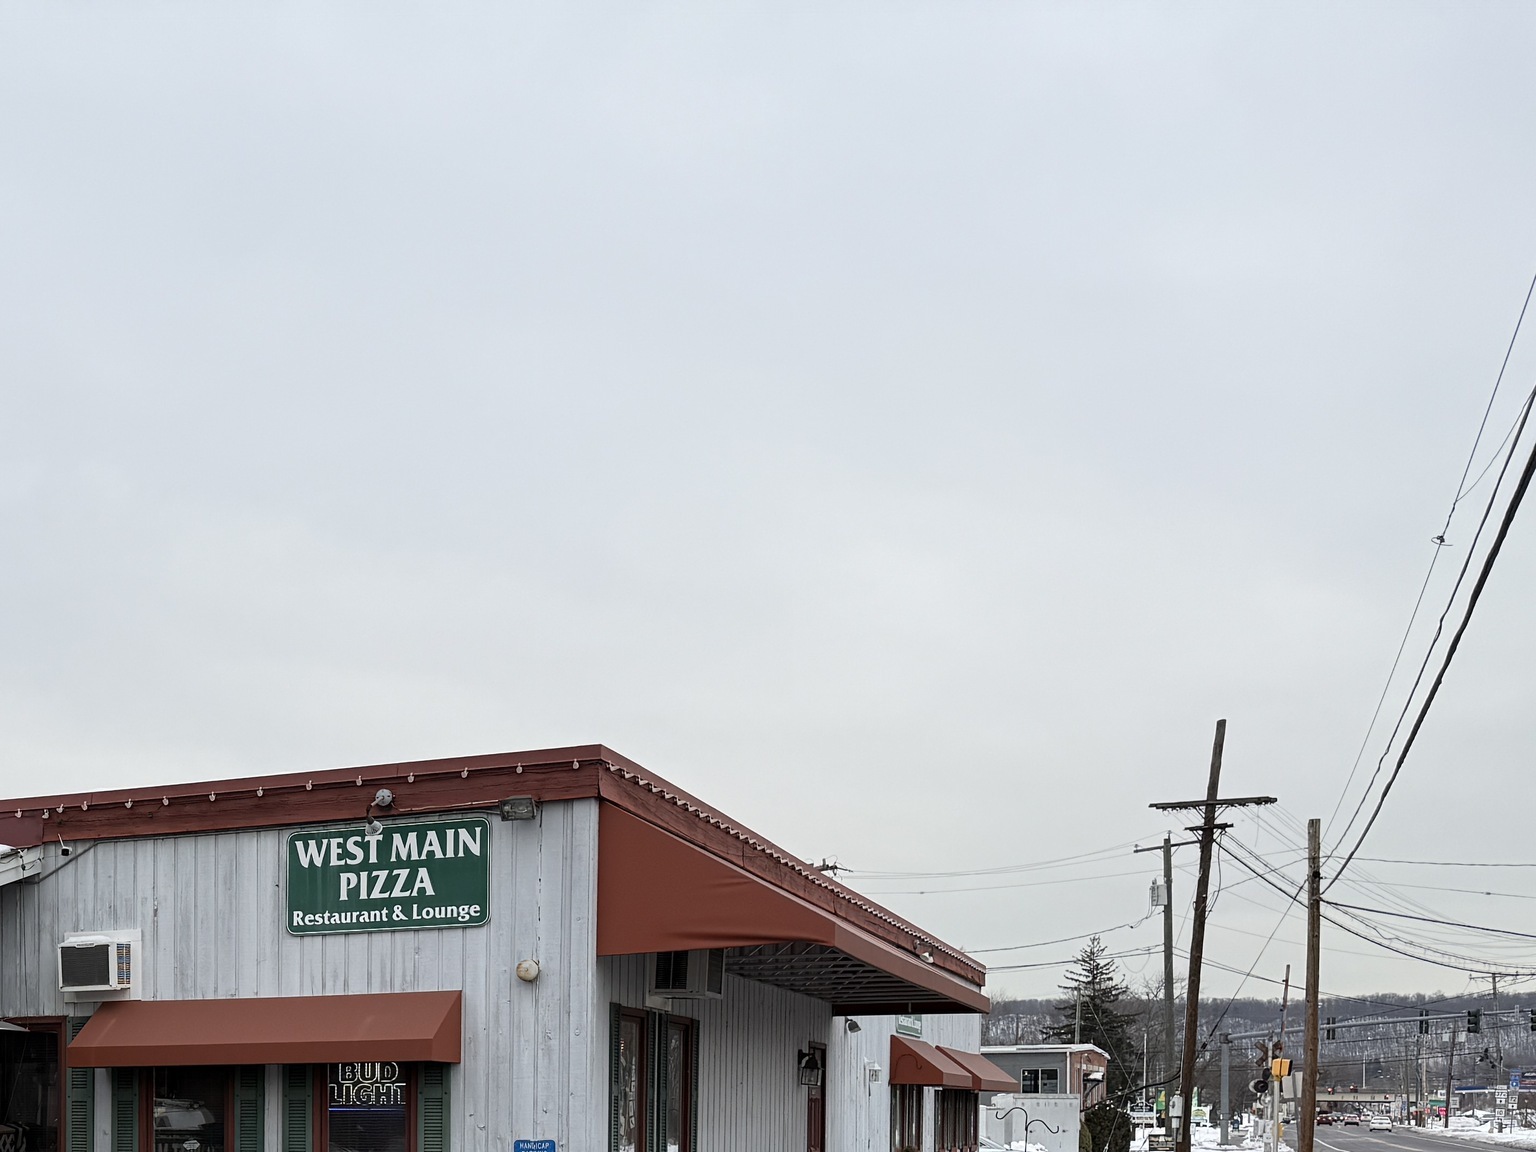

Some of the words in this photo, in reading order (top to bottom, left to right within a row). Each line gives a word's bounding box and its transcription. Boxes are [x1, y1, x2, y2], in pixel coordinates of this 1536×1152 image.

[294, 834, 383, 868] WEST
[390, 827, 482, 862] MAIN
[339, 867, 436, 901] PIZZA
[292, 906, 388, 926] Restaurant
[392, 905, 408, 920] &
[412, 903, 481, 922] Lounge
[339, 1062, 399, 1083] BUD
[328, 1083, 407, 1105] LIGHT
[519, 1142, 550, 1150] HANDICAP
